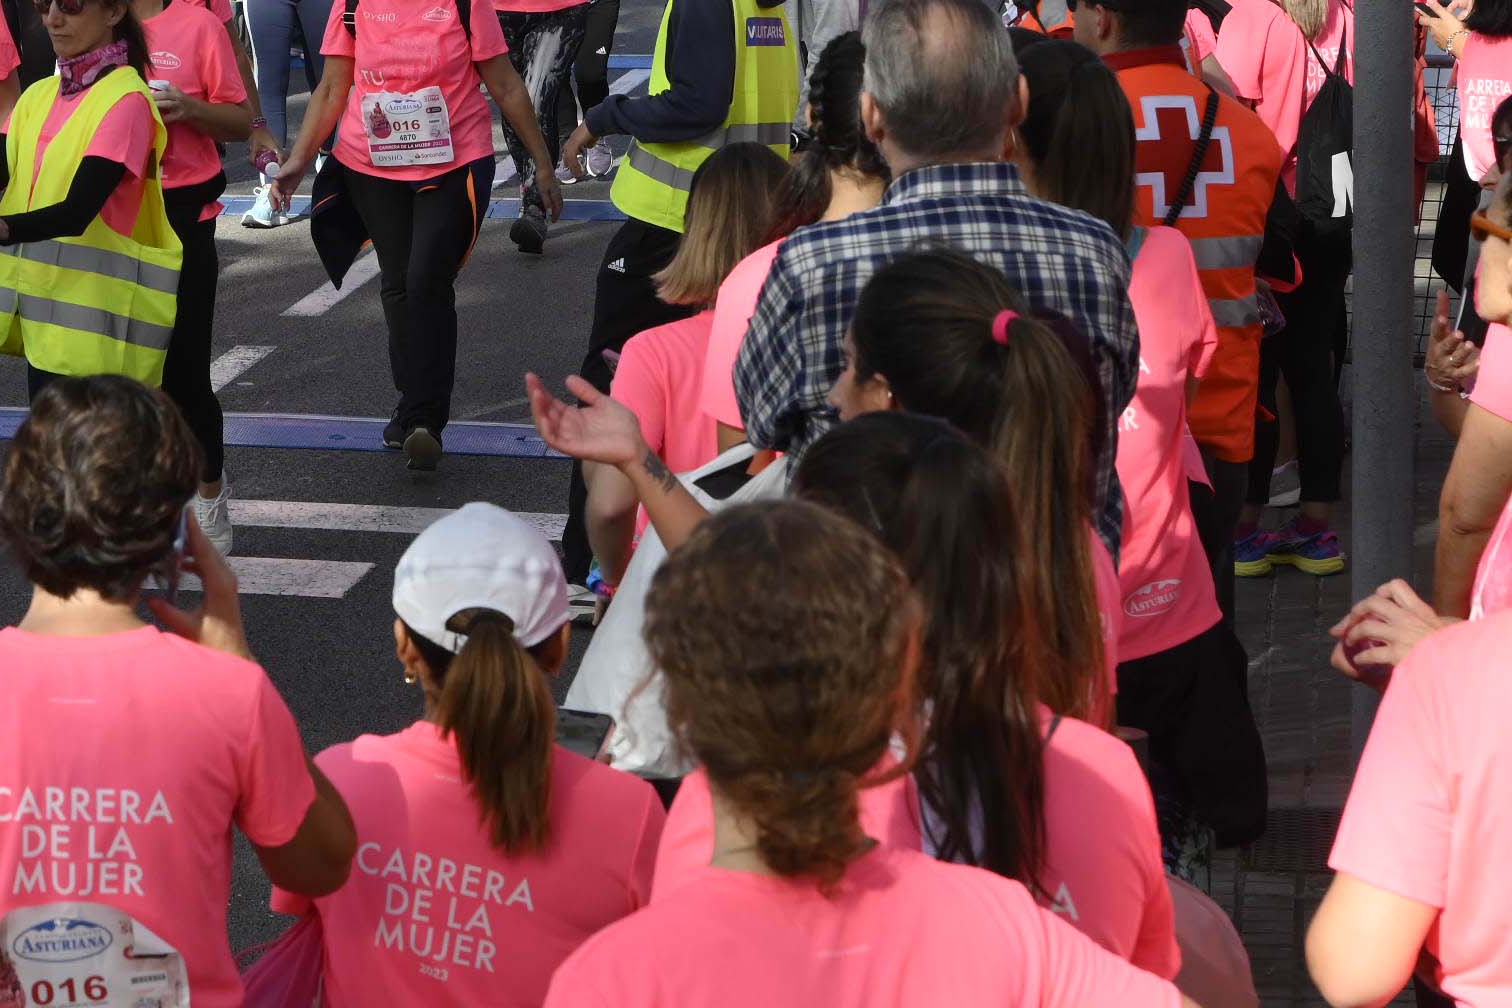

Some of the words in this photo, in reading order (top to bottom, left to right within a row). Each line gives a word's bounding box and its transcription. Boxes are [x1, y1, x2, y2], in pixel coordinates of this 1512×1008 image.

[392, 119, 421, 132] 016
[399, 133, 417, 142] 4870
[20, 825, 75, 861] DE
[88, 825, 136, 860] LA
[12, 860, 145, 896] MUJER
[357, 840, 535, 914] CARRERA
[383, 883, 431, 924] DE
[449, 900, 492, 938] LA
[21, 935, 105, 955] ASTURIANA
[374, 919, 497, 974] MUJER
[419, 963, 449, 982] 2023
[31, 975, 108, 1006] 016
